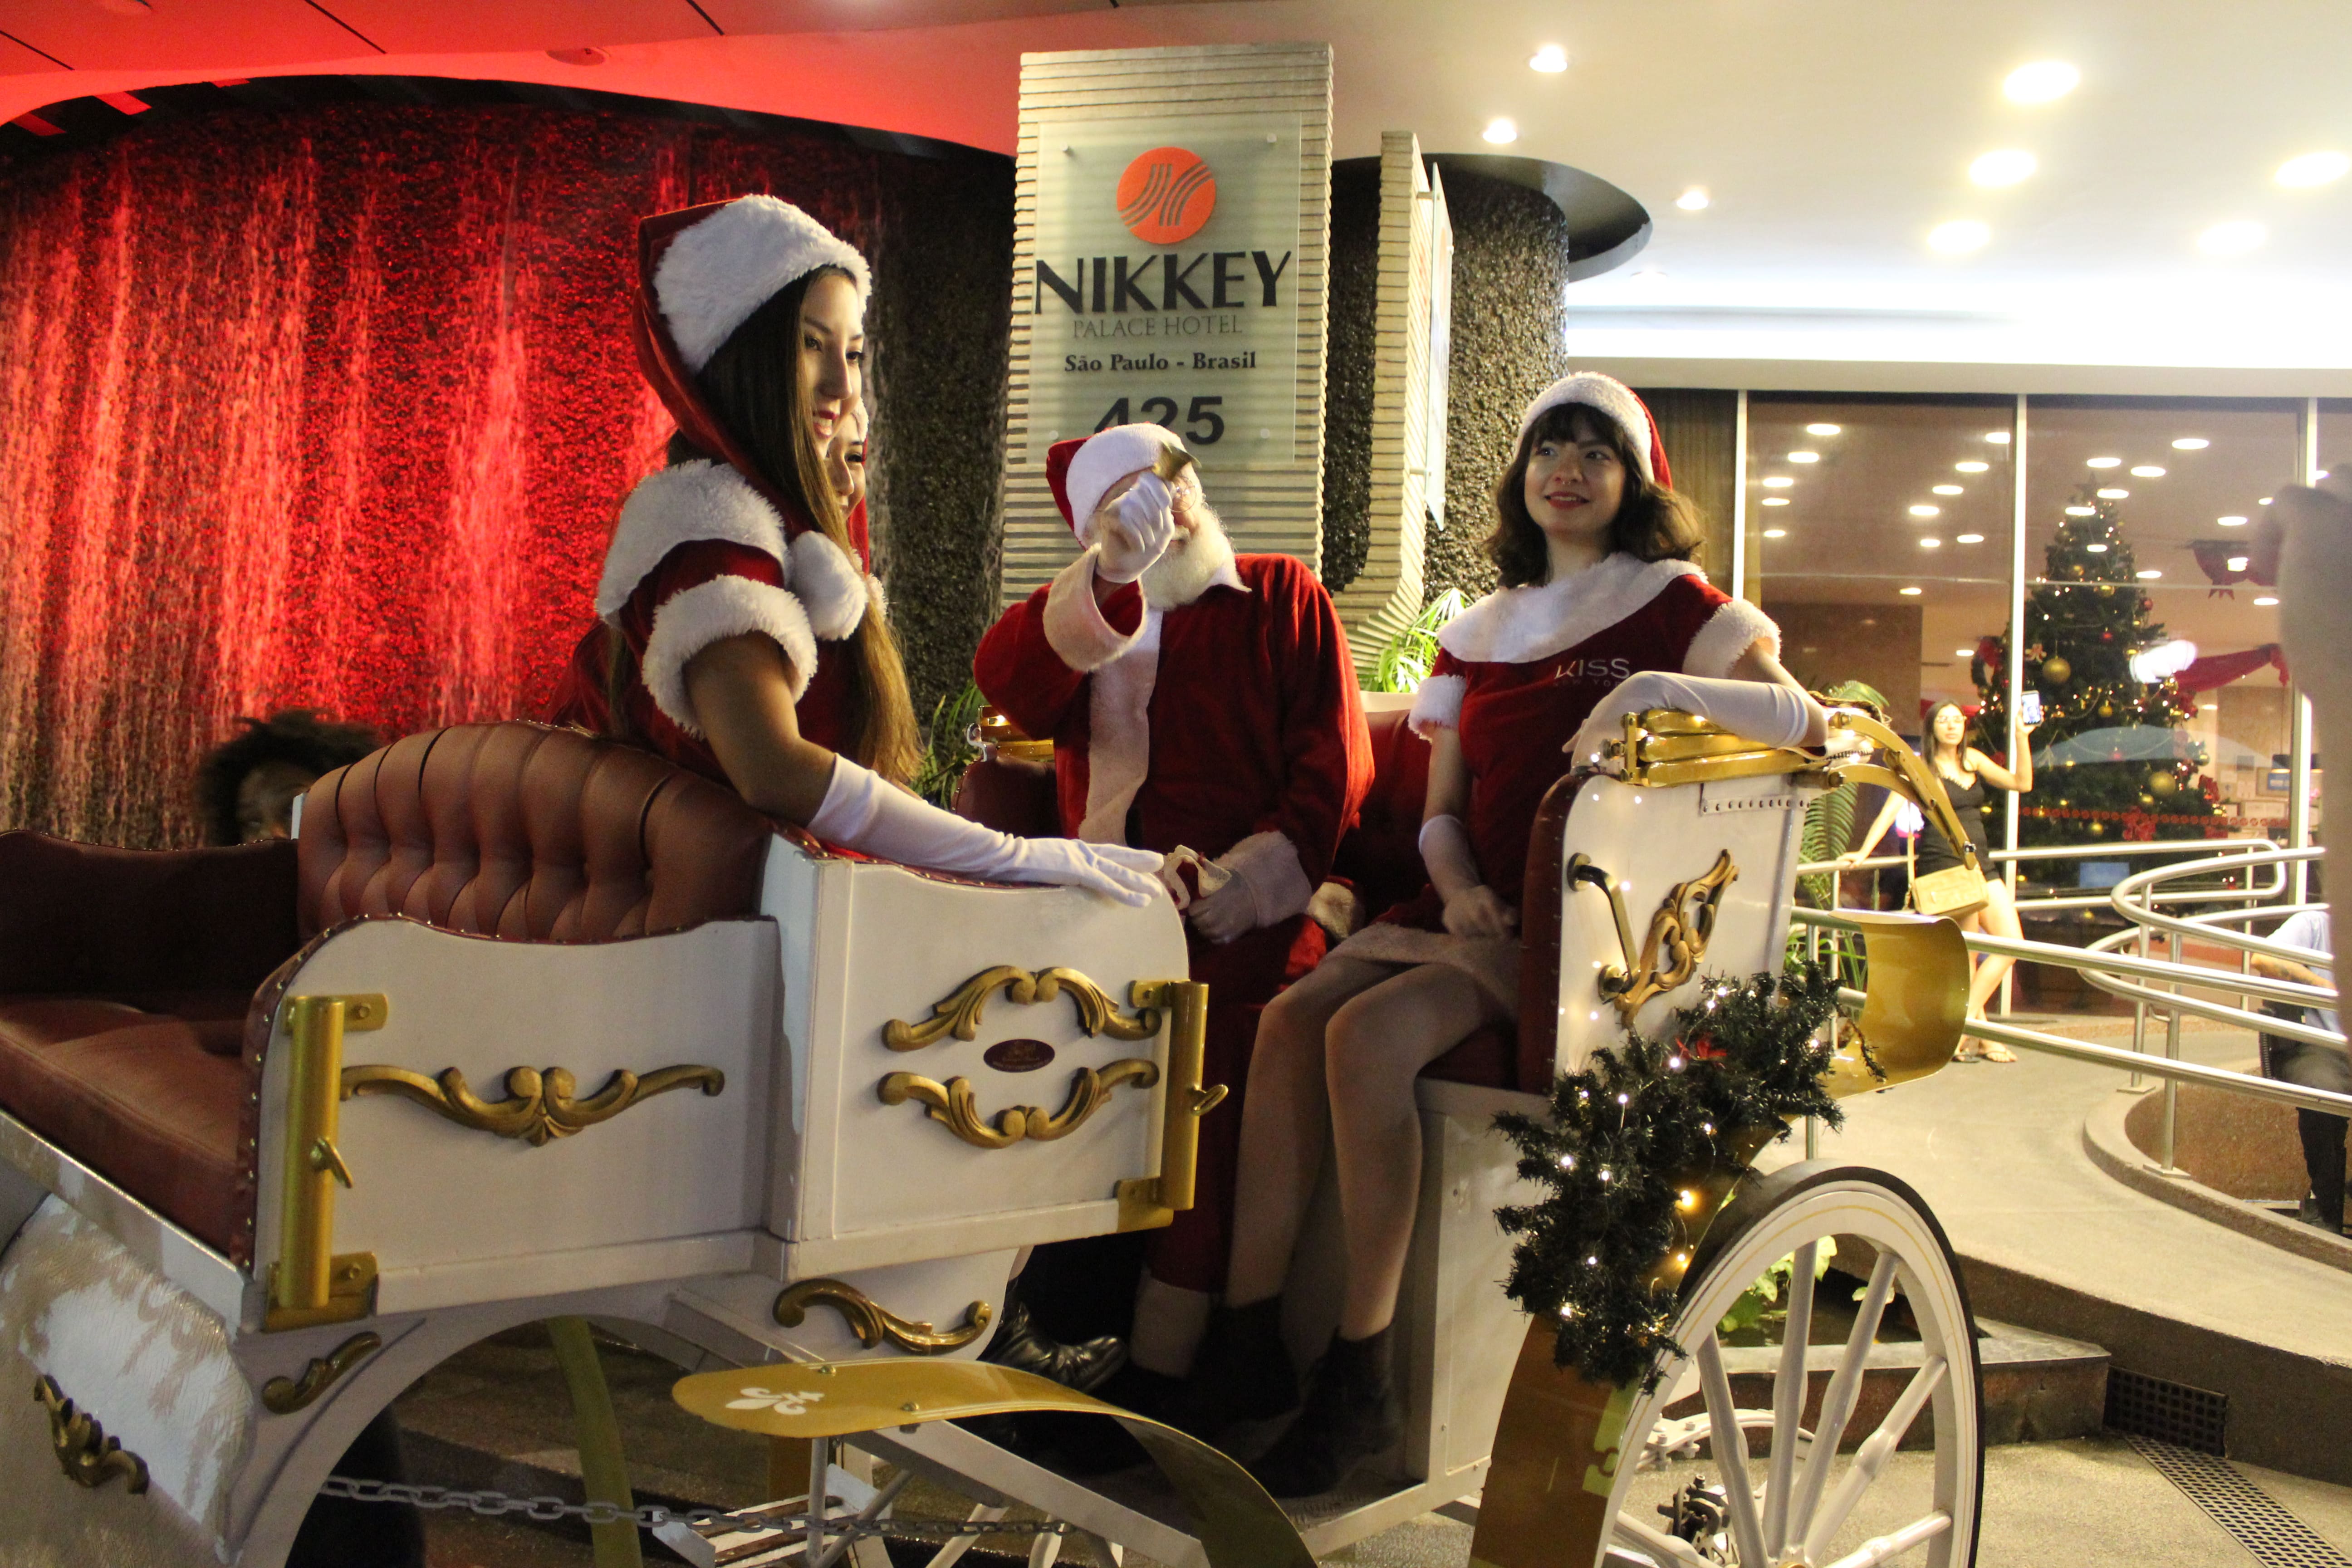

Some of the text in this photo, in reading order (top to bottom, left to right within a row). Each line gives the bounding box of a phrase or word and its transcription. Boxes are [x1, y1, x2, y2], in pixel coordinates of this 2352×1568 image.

[1035, 250, 1292, 314] NIKKEY
[1073, 315, 1243, 338] PALACE HOTEL
[1064, 354, 1102, 372] São
[1110, 353, 1169, 371] Paulo
[1192, 351, 1256, 370] Brasil
[1094, 396, 1225, 445] 425
[1553, 657, 1630, 679] KISS
